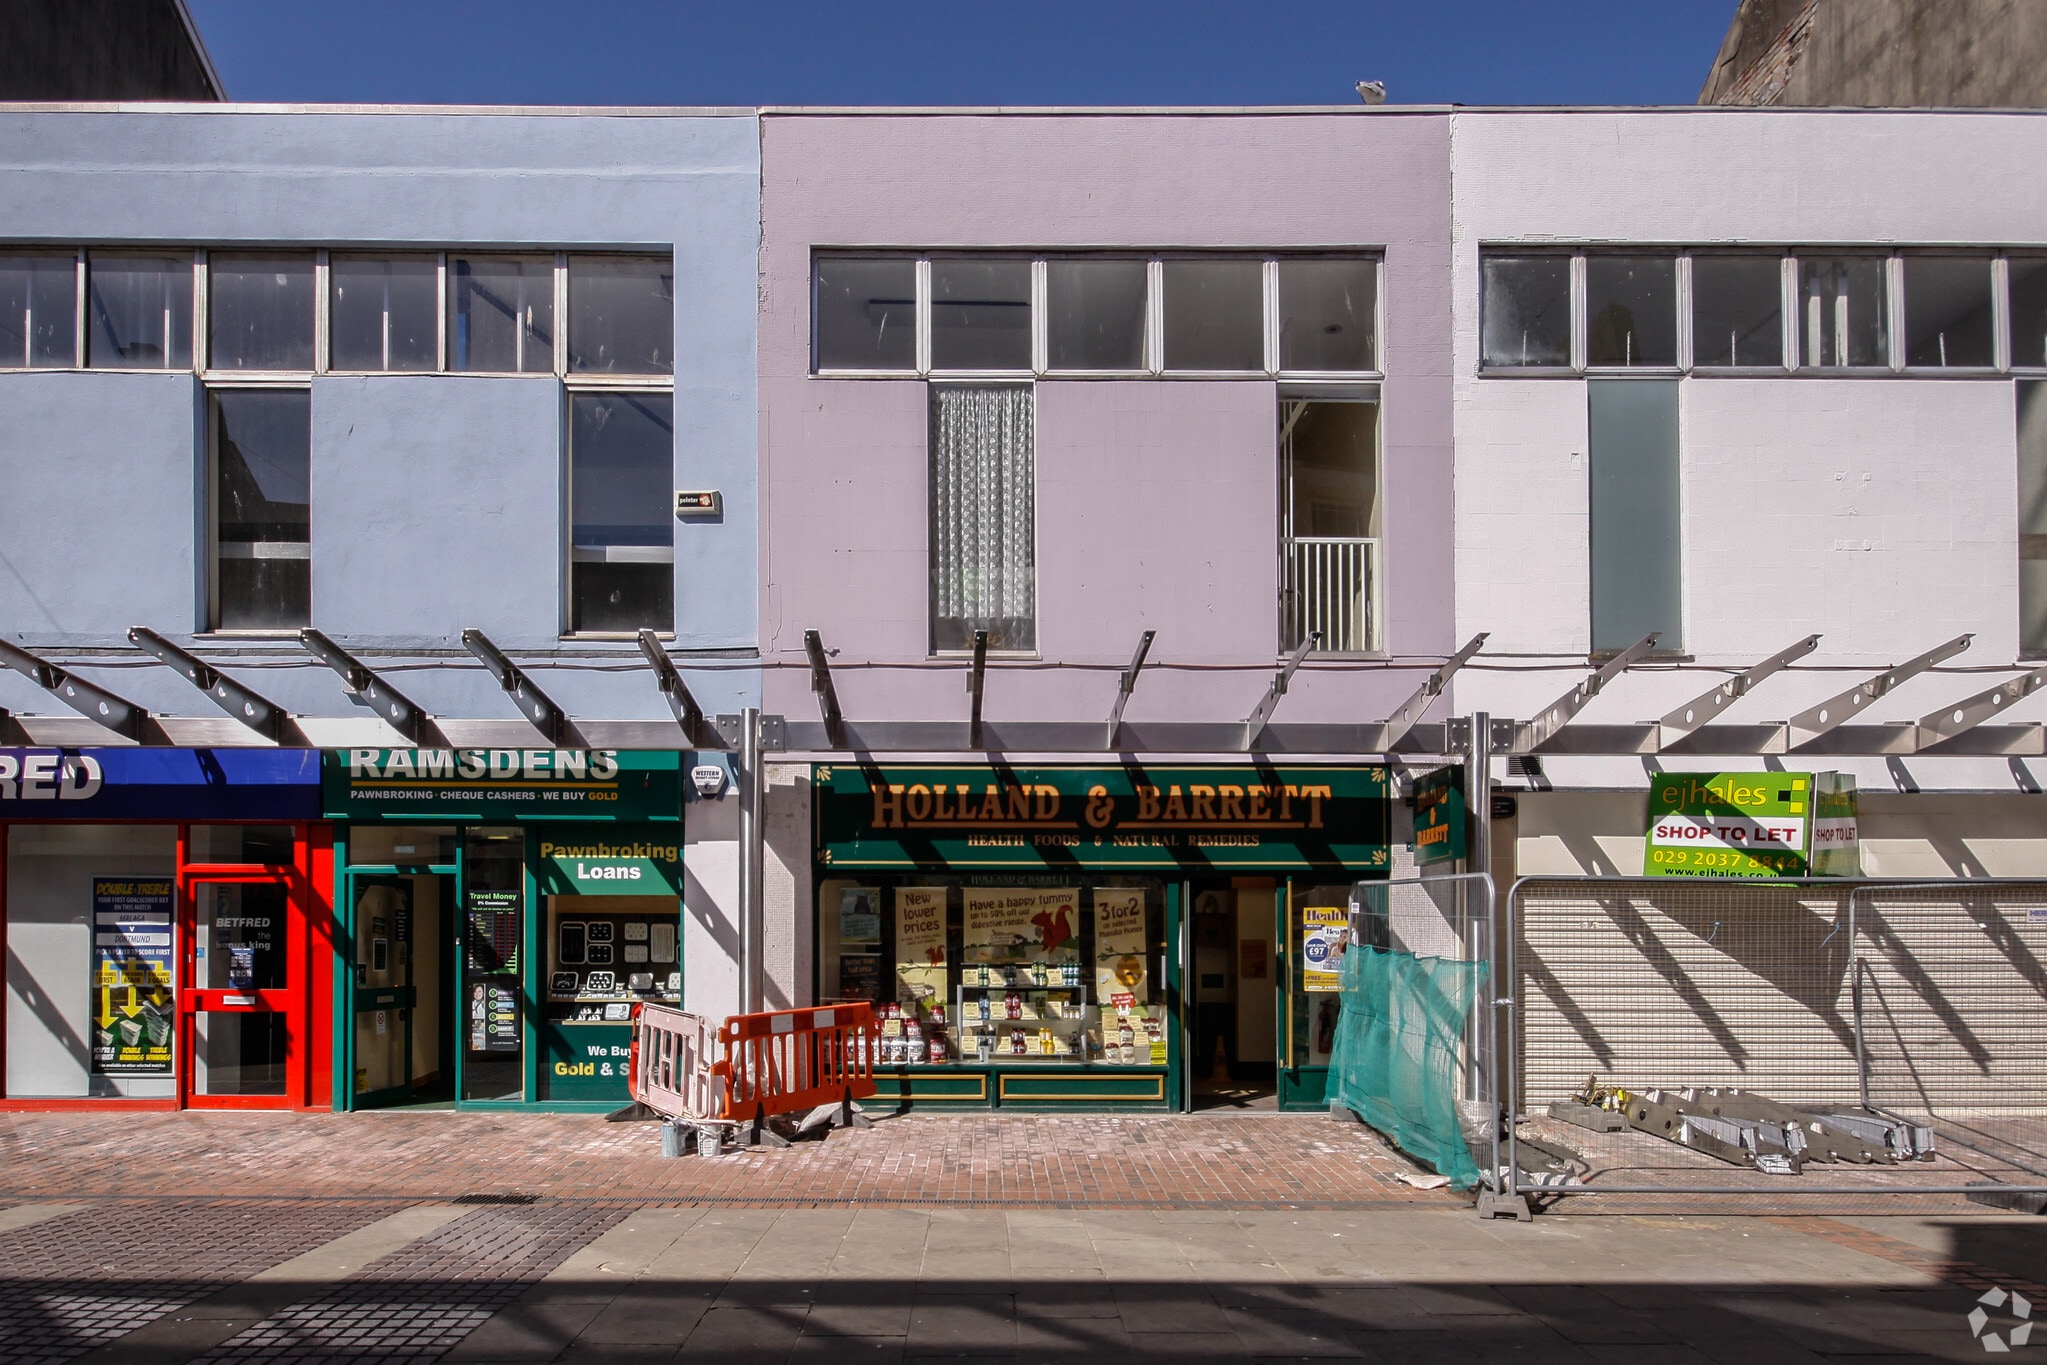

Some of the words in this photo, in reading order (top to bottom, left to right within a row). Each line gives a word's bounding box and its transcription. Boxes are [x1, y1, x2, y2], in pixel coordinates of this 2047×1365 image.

[350, 749, 619, 780] RAMSDENS
[350, 790, 434, 800] PAWNBROKING
[440, 791, 484, 800] CHEQUE
[486, 791, 536, 800] CASHERS
[542, 792, 560, 800] WE
[562, 792, 585, 800] BUY
[588, 792, 618, 801] GOLD
[1662, 779, 1768, 811] ejhales
[871, 784, 1061, 828] HOLLAND
[1085, 784, 1115, 828] &
[1136, 784, 1332, 828] BARRETT
[968, 834, 1024, 847] HEALTH
[1034, 834, 1080, 847] FOODS
[1094, 836, 1102, 847] &
[1113, 834, 1180, 847] NATURAL
[1188, 834, 1260, 847] REMEDIES
[1416, 824, 1448, 849] BARRETT
[1656, 826, 1711, 839] SHOP
[1717, 826, 1746, 841] TO
[1754, 828, 1796, 842] LET
[1816, 829, 1834, 842] SHOP
[1836, 828, 1844, 841] TO
[1846, 827, 1856, 840] LET
[540, 842, 678, 862] Pawnbroking
[1653, 850, 1687, 864] 029
[1693, 852, 1742, 867] 2037
[1748, 855, 1799, 870] 8844
[578, 863, 641, 879] Loans
[971, 875, 1016, 885] HOLLAND
[96, 883, 134, 895] DOUBLE
[138, 883, 170, 895] TREBLE
[905, 894, 931, 906] New
[969, 900, 995, 910] Have
[998, 900, 1004, 908] a
[1007, 896, 1035, 908] happy
[1038, 894, 1073, 905] tummy
[904, 906, 936, 920] lower
[981, 910, 988, 918] to
[990, 909, 1005, 918] 50%
[1099, 902, 1110, 920] 3
[1111, 905, 1128, 919] for
[1128, 897, 1140, 916] 2
[1307, 910, 1348, 921] Health
[216, 918, 270, 928] BETFRED
[904, 920, 940, 934] prices
[971, 920, 1004, 929] digestive
[1112, 918, 1137, 927] selected
[258, 931, 270, 940] the
[1099, 929, 1123, 938] Manuka
[1124, 926, 1143, 935] Honey
[249, 941, 271, 950] king
[588, 1045, 608, 1056] We
[611, 1046, 632, 1058] Buy
[554, 1062, 594, 1076] Gold
[600, 1062, 614, 1076] &
